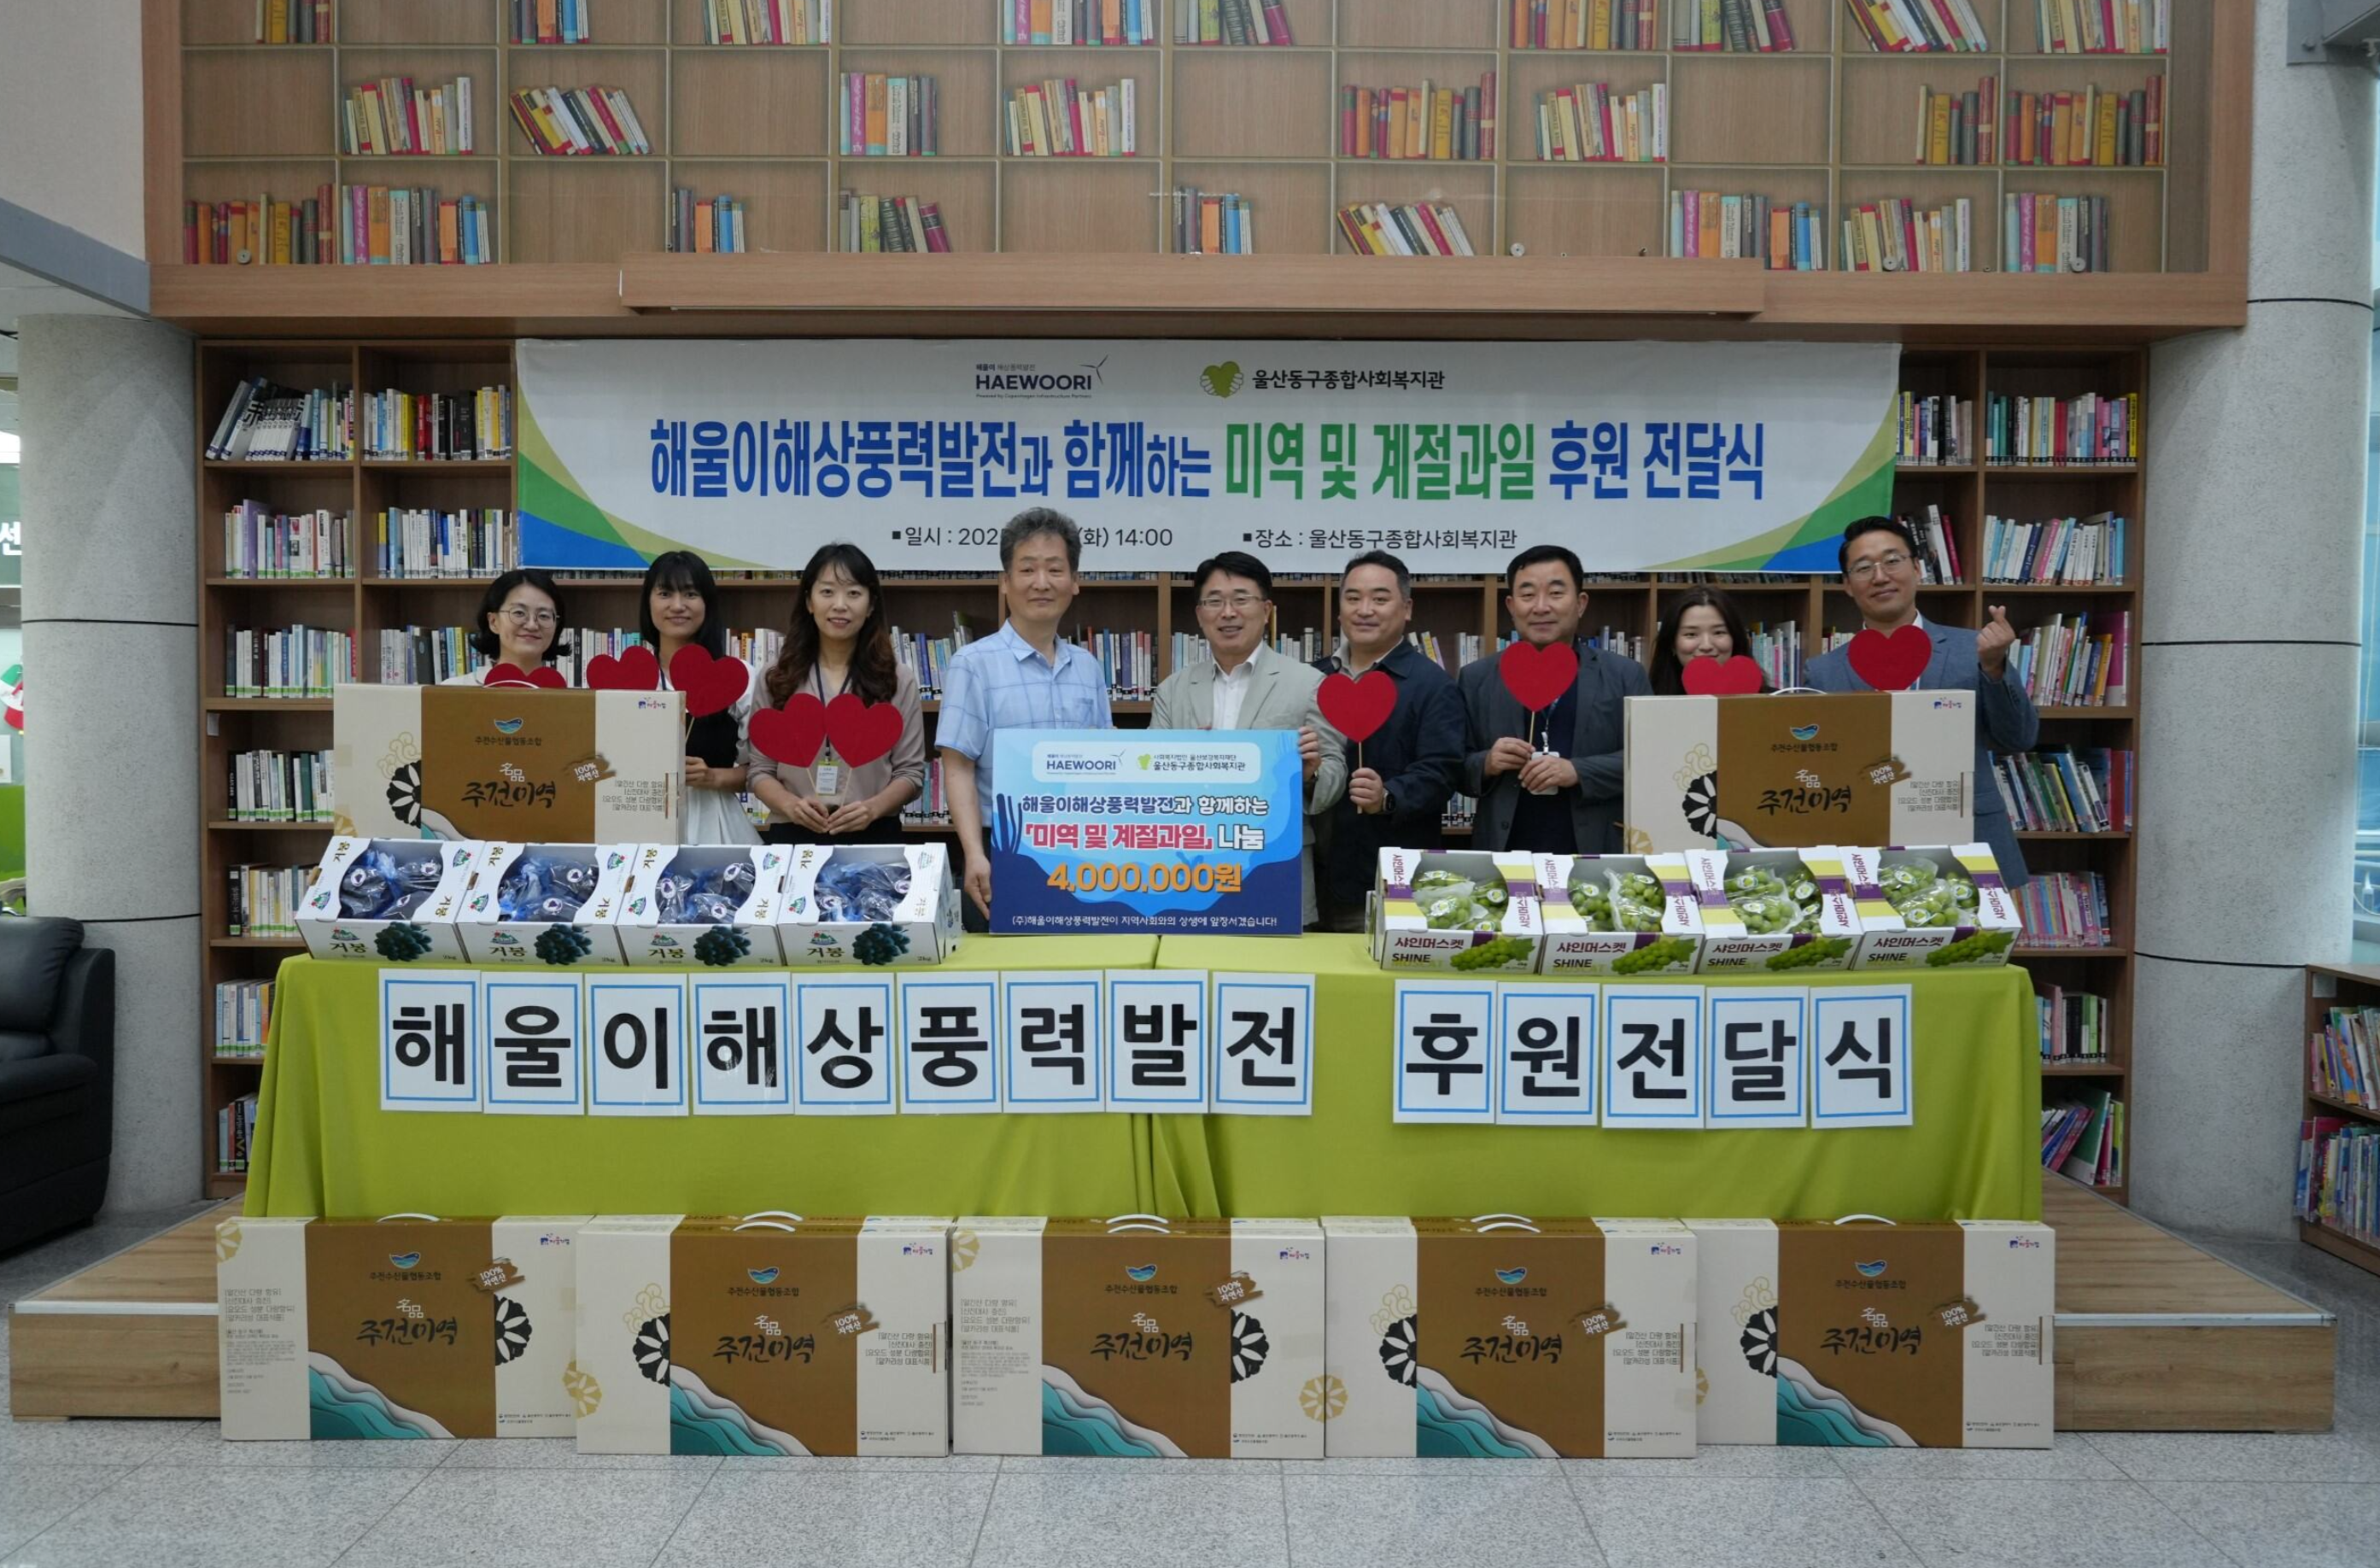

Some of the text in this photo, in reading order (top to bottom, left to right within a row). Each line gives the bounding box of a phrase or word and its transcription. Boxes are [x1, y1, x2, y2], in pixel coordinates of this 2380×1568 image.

[975, 375, 1091, 390] HAEWOORI
[1252, 369, 1445, 390] 울산동구종합사회복지관
[651, 418, 1764, 500] 해울이해상풍력발전과 함께하는 미역 및 계절과일 후원 전달식
[905, 527, 941, 547] 일시
[958, 529, 1000, 546] 202
[1077, 527, 1108, 547] (화)
[1115, 529, 1173, 546] 14:00
[1254, 528, 1292, 548] 장소
[1309, 527, 1517, 549] 울산동구종합사회복지관
[475, 735, 542, 746] 주전수산물협동조합
[1771, 743, 1838, 753] 주전수산물협동조합
[574, 762, 597, 776] 100%
[1046, 760, 1116, 770] HAEWOORI
[1154, 761, 1246, 771] 울산동구종합사회복지관
[1870, 764, 1892, 779] 100%
[500, 763, 525, 782] 名品
[1795, 769, 1821, 788] 名品
[1021, 794, 1270, 816] 해울이해상풍력발전과 함께하는
[1085, 824, 1108, 849] 및
[1217, 824, 1266, 851] 나눔
[1047, 862, 1242, 893] 4,000,000원
[1012, 915, 1278, 928] (주)해울이해상풍력발전이 지역사회와의 상생에 앞장서겠습니다!
[330, 942, 369, 954] 거봉
[1395, 937, 1465, 950] 샤인머스켓
[1556, 942, 1626, 954] 샤인머스켓
[1712, 942, 1783, 954] 샤인머스켓
[1874, 936, 1944, 949] 샤인머스켓
[489, 946, 528, 957] 거봉
[648, 948, 687, 958] 거봉
[807, 947, 845, 957] 거봉
[1392, 953, 1431, 963] SHINE
[1868, 952, 1907, 962] SHINE
[1553, 957, 1592, 968] SHINE
[1707, 957, 1747, 967] SHINE
[370, 1272, 441, 1282] 주전수산물협동조합
[479, 1266, 504, 1282] 100%
[1105, 1284, 1178, 1295] 주전수산물협동조합
[1217, 1280, 1242, 1296] 100%
[1836, 1279, 1906, 1290] 주전수산물협동조합
[728, 1287, 799, 1297] 주전수산물협동조합
[1475, 1287, 1547, 1297] 주전수산물협동조합
[396, 1298, 424, 1318] 名品
[1941, 1306, 1966, 1320] 100%
[834, 1315, 858, 1329] 100%
[1132, 1312, 1159, 1333] 名品
[1582, 1313, 1606, 1328] 100%
[1861, 1307, 1888, 1328] 名品
[754, 1315, 781, 1336] 名品
[1501, 1315, 1529, 1336] 名品
